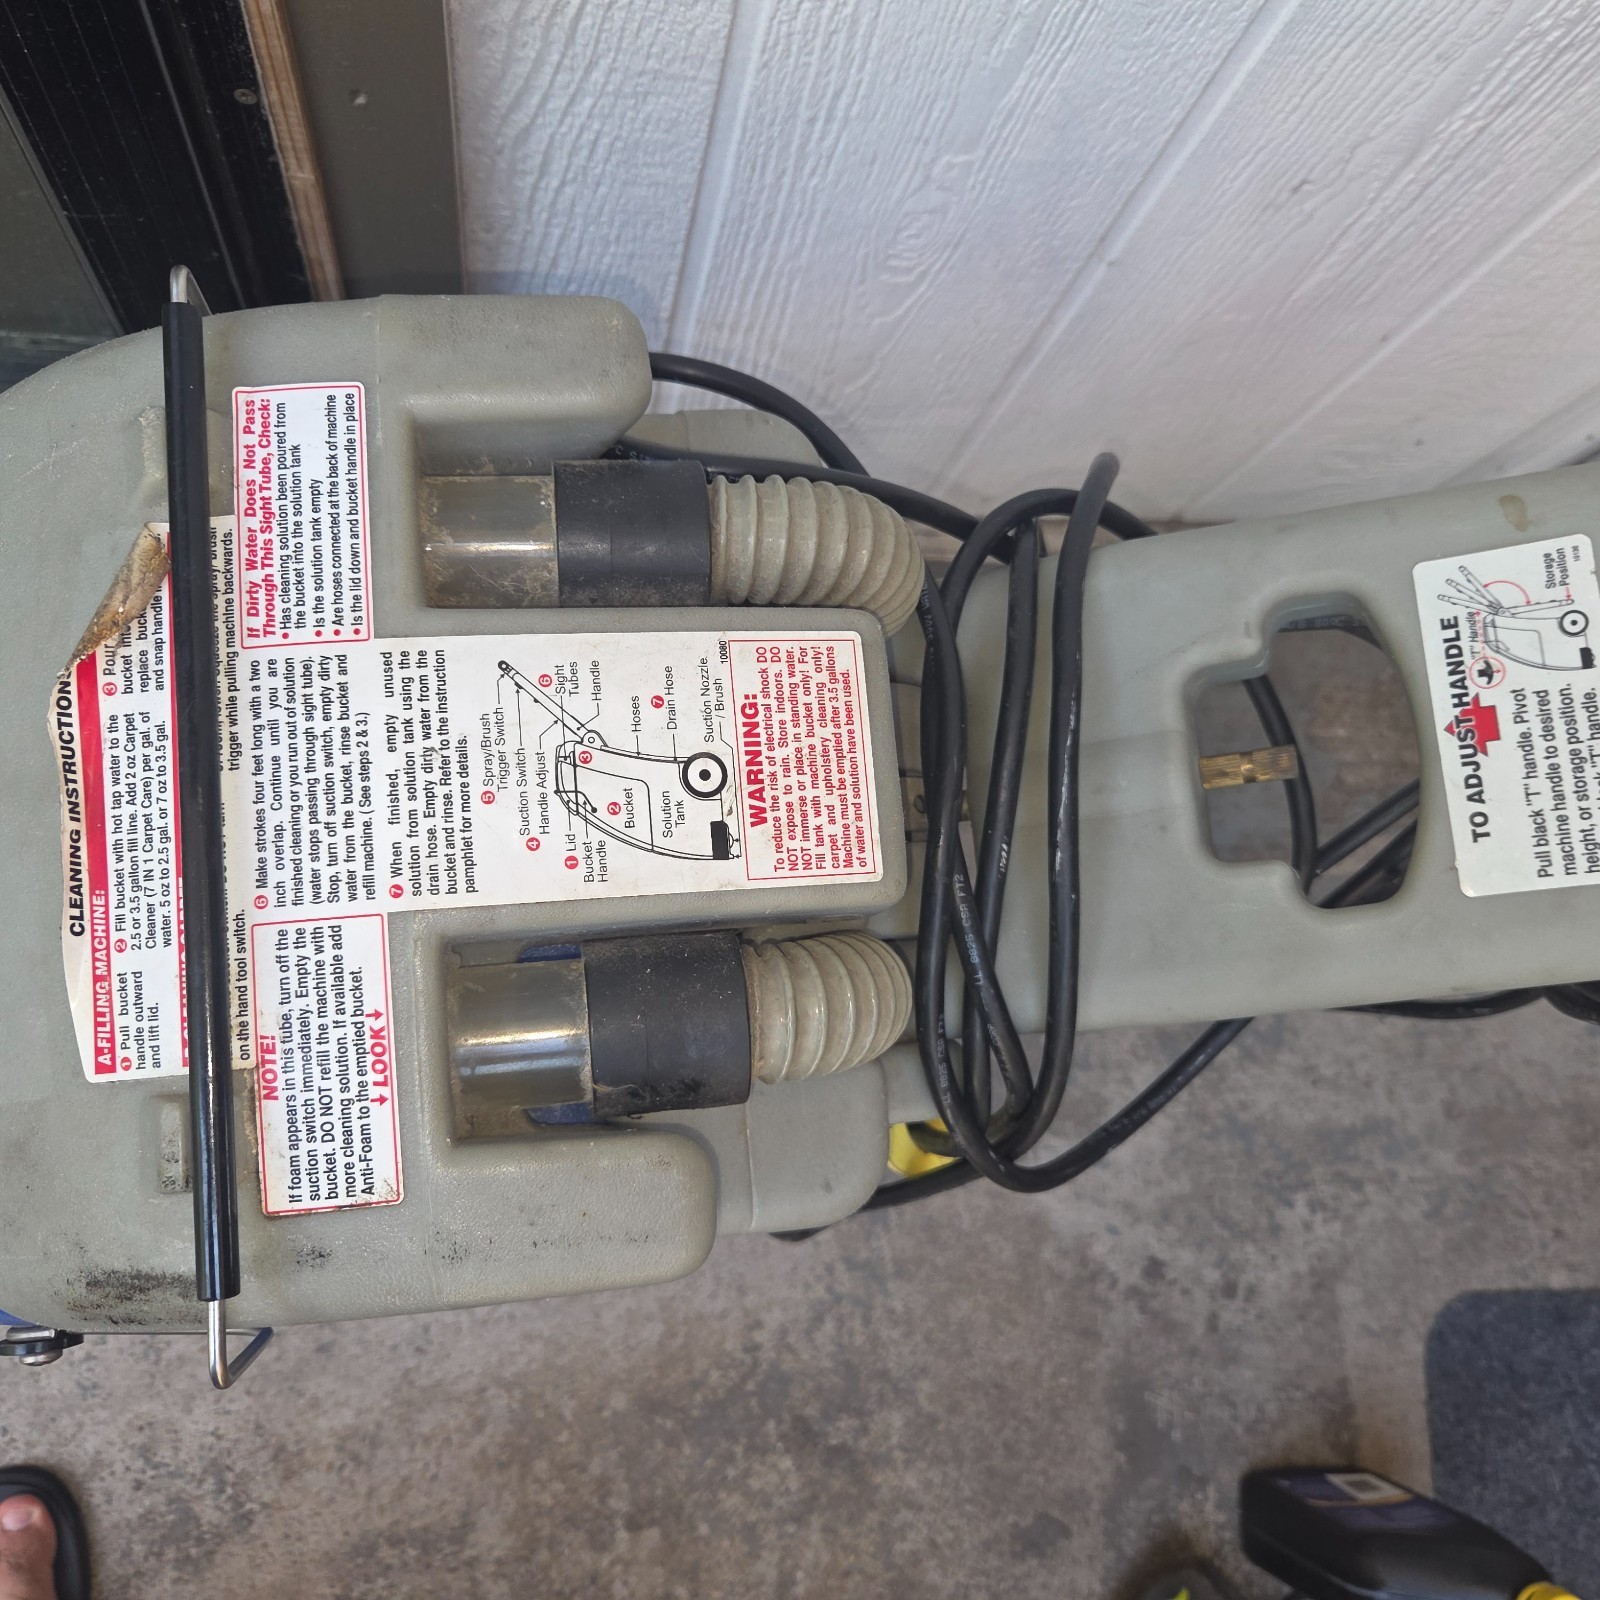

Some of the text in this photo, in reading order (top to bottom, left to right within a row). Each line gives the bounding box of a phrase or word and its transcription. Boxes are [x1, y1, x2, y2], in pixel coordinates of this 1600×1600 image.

[242, 400, 263, 638] If Dirty Water Does Not Pass
[257, 399, 278, 638] Through This Sight Tube, Check:
[342, 393, 363, 626] Is the lid down and bucket handle in place
[308, 479, 325, 628] Is the solution tank empty
[1543, 551, 1560, 589] Storage
[1554, 546, 1570, 586] Position
[103, 643, 117, 676] Pour
[151, 595, 166, 691] and snap handle
[220, 528, 243, 771] trigger while pulling machine backwards.
[1465, 610, 1484, 660] "T" Handle
[137, 649, 152, 693] replace
[248, 660, 261, 682] two
[555, 664, 567, 695] Sight
[568, 661, 580, 696] Tubes
[590, 660, 602, 701] Handle
[664, 665, 677, 730] Drain Hose
[697, 656, 715, 743] Suction Nozzle
[712, 678, 725, 711] Brush
[248, 696, 262, 721] with
[250, 724, 266, 751] long
[631, 695, 642, 732] Hoses
[1440, 615, 1491, 843] TO ADJUST HANDLE
[251, 754, 264, 777] feet
[379, 652, 403, 879] When finished, empty unused
[480, 712, 495, 786] Spray/Brush
[492, 707, 510, 792] Trigger Switch
[740, 694, 768, 828] WARNING:
[755, 646, 785, 873] To reduce the risk of electrical shock DO
[1509, 688, 1554, 878] Pull black "T" handle. Pivot
[1531, 689, 1578, 876] machine handle to desired
[106, 714, 126, 932] Fill bucket with hot tap water to the
[252, 780, 265, 805] four
[455, 735, 479, 893] pamphlet for more details.
[515, 747, 531, 835] Suction Switch
[535, 751, 550, 835] Handle Adjust
[623, 788, 635, 829] Bucket
[661, 790, 673, 838] Solution
[674, 800, 686, 828] Tank
[253, 808, 267, 853] strokes
[564, 834, 577, 852] Lid
[582, 841, 595, 883] Bucket
[595, 840, 608, 883] Handle
[69, 829, 85, 937] CLEANING
[255, 857, 268, 889] Make
[93, 890, 112, 1065] A-FILLING MACHINE:
[116, 972, 131, 1050] Pull bucket
[232, 909, 251, 1061] on the hand tool switch.
[131, 971, 146, 1070] handle outward
[147, 1002, 161, 1068] and lift lid.
[370, 1024, 390, 1087] LOOK
[260, 1034, 280, 1100] NOTE!
[274, 929, 303, 1203] If foam appears in this tube, turn off the
[292, 928, 321, 1201] suction switch immediately. Empty the
[310, 926, 339, 1200] bucket. DO NOT refill the machine with
